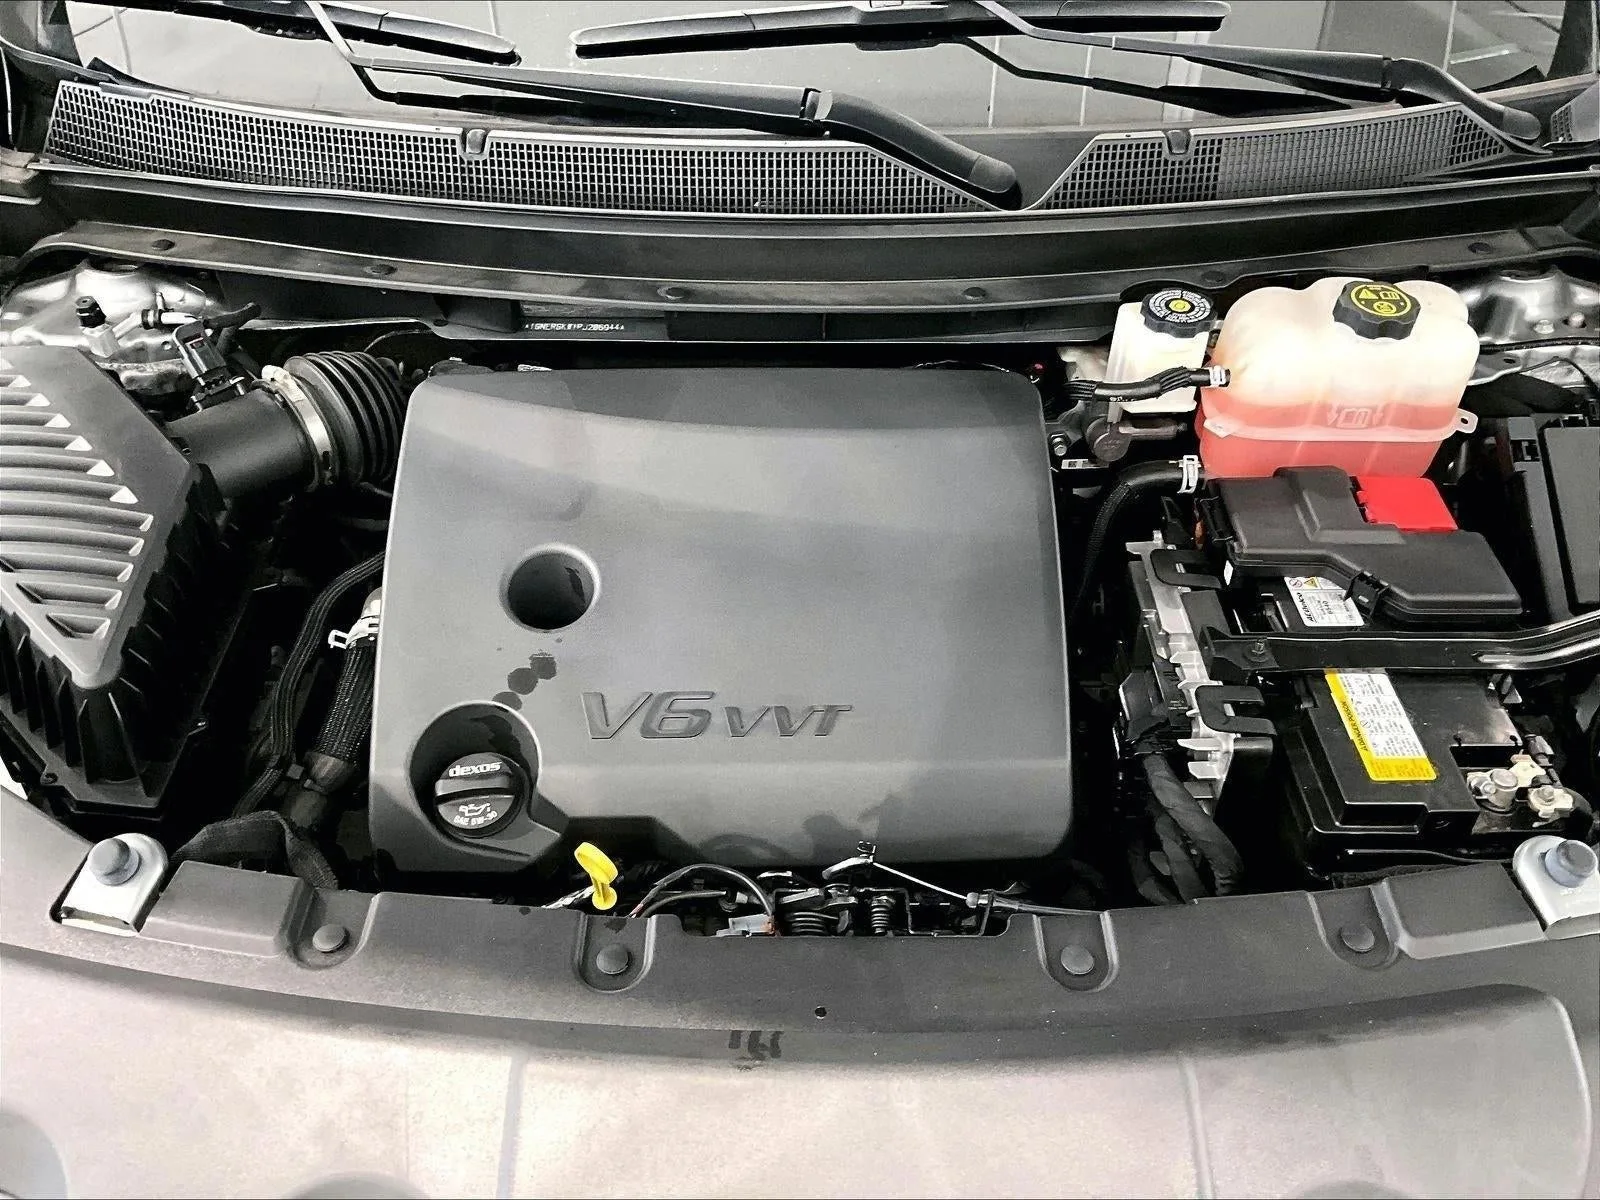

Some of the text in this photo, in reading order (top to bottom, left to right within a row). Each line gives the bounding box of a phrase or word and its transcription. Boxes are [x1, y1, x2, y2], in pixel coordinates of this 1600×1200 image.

[580, 690, 853, 740] V6 VVT
[448, 761, 503, 778] dexos
[453, 814, 470, 826] SAE
